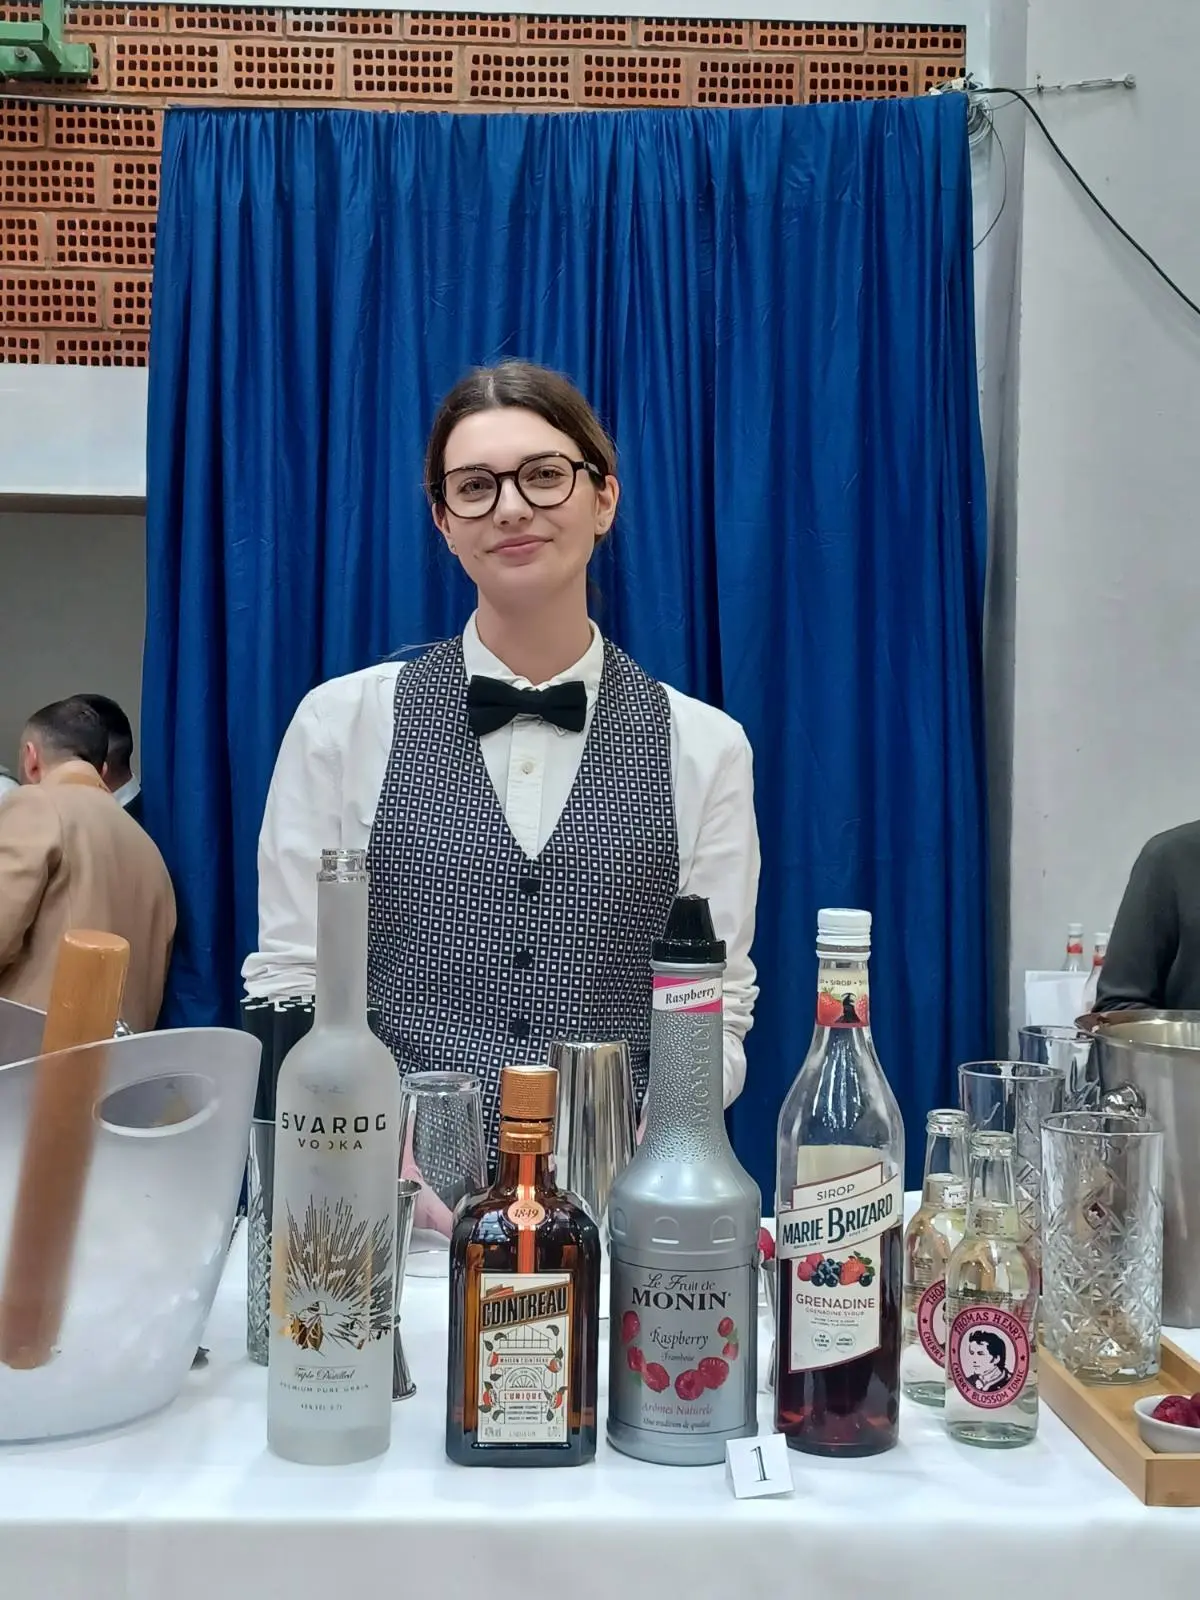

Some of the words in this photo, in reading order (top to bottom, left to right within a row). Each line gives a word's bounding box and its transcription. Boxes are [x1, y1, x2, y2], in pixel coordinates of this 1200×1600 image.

[665, 986, 716, 1005] Raspberry
[281, 1112, 387, 1134] SVAROG
[817, 1184, 855, 1201] SIROP
[513, 1208, 539, 1219] 1849
[782, 1218, 824, 1246] MARIE
[827, 1193, 893, 1244] BRIZARD
[643, 1273, 663, 1288] Le
[482, 1286, 568, 1329] COINTREAU
[631, 1287, 729, 1311] MONIN
[795, 1293, 876, 1309] GRENADINE
[650, 1326, 709, 1350] Raspberry
[954, 1312, 989, 1336] THOMAS
[993, 1315, 1024, 1341] HENRY
[923, 1331, 946, 1360] CHERRY
[952, 1362, 971, 1393] CHERRY
[971, 1391, 1009, 1404] BLOSSOM
[1008, 1369, 1025, 1393] TONIC
[751, 1446, 772, 1482] 1
